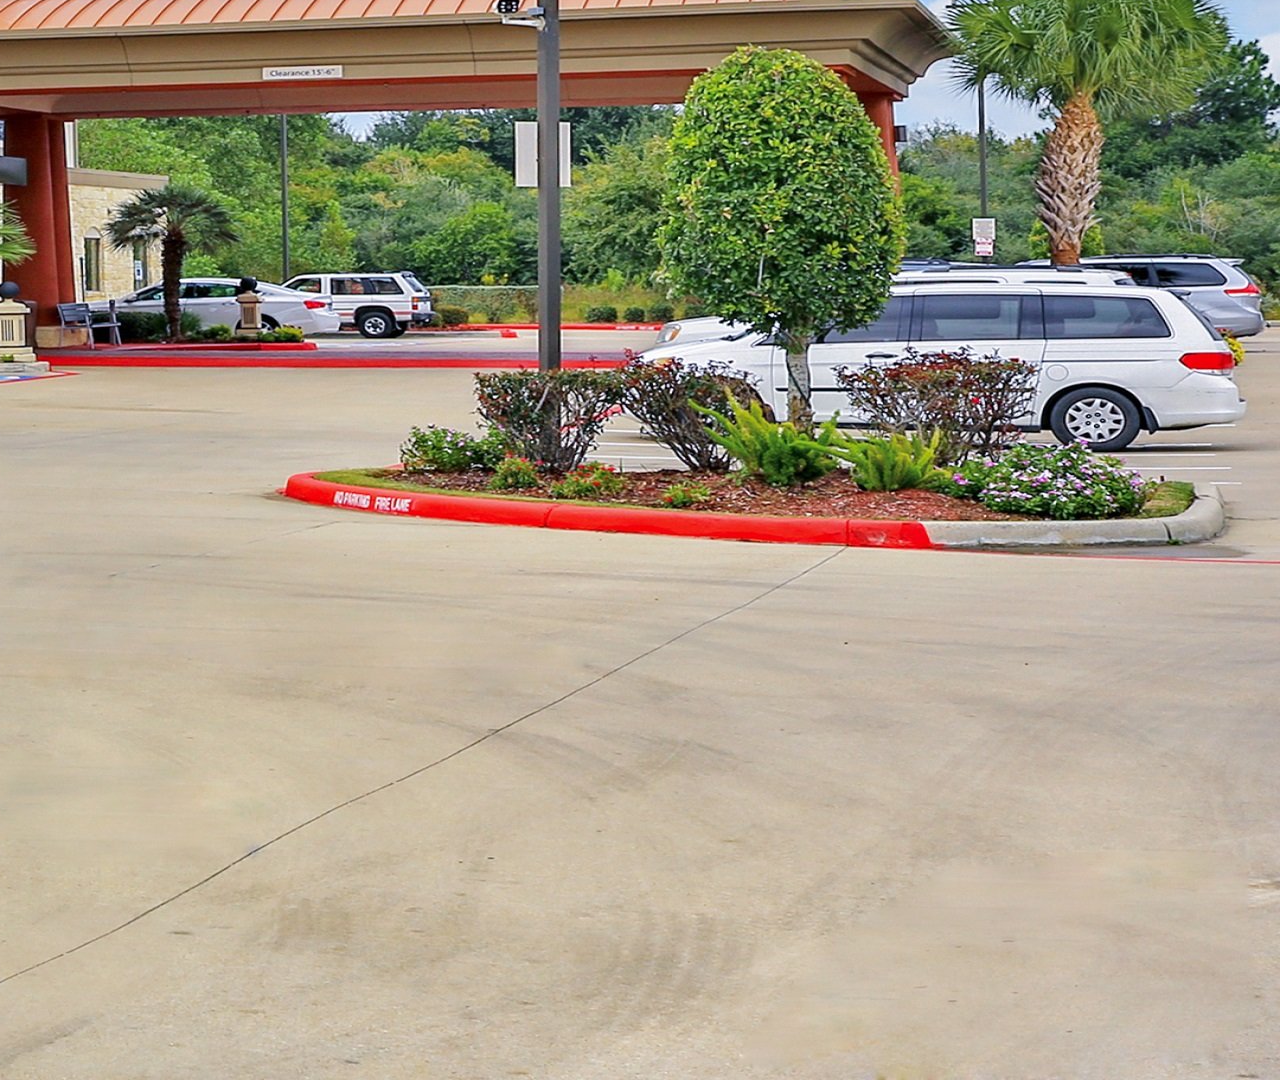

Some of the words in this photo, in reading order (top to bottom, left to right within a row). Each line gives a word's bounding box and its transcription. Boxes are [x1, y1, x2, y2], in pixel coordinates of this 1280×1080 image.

[269, 69, 310, 78] Clearance
[334, 491, 343, 504] NO
[343, 492, 370, 508] PARKING
[375, 497, 391, 511] FIRE
[391, 498, 411, 511] LANE
